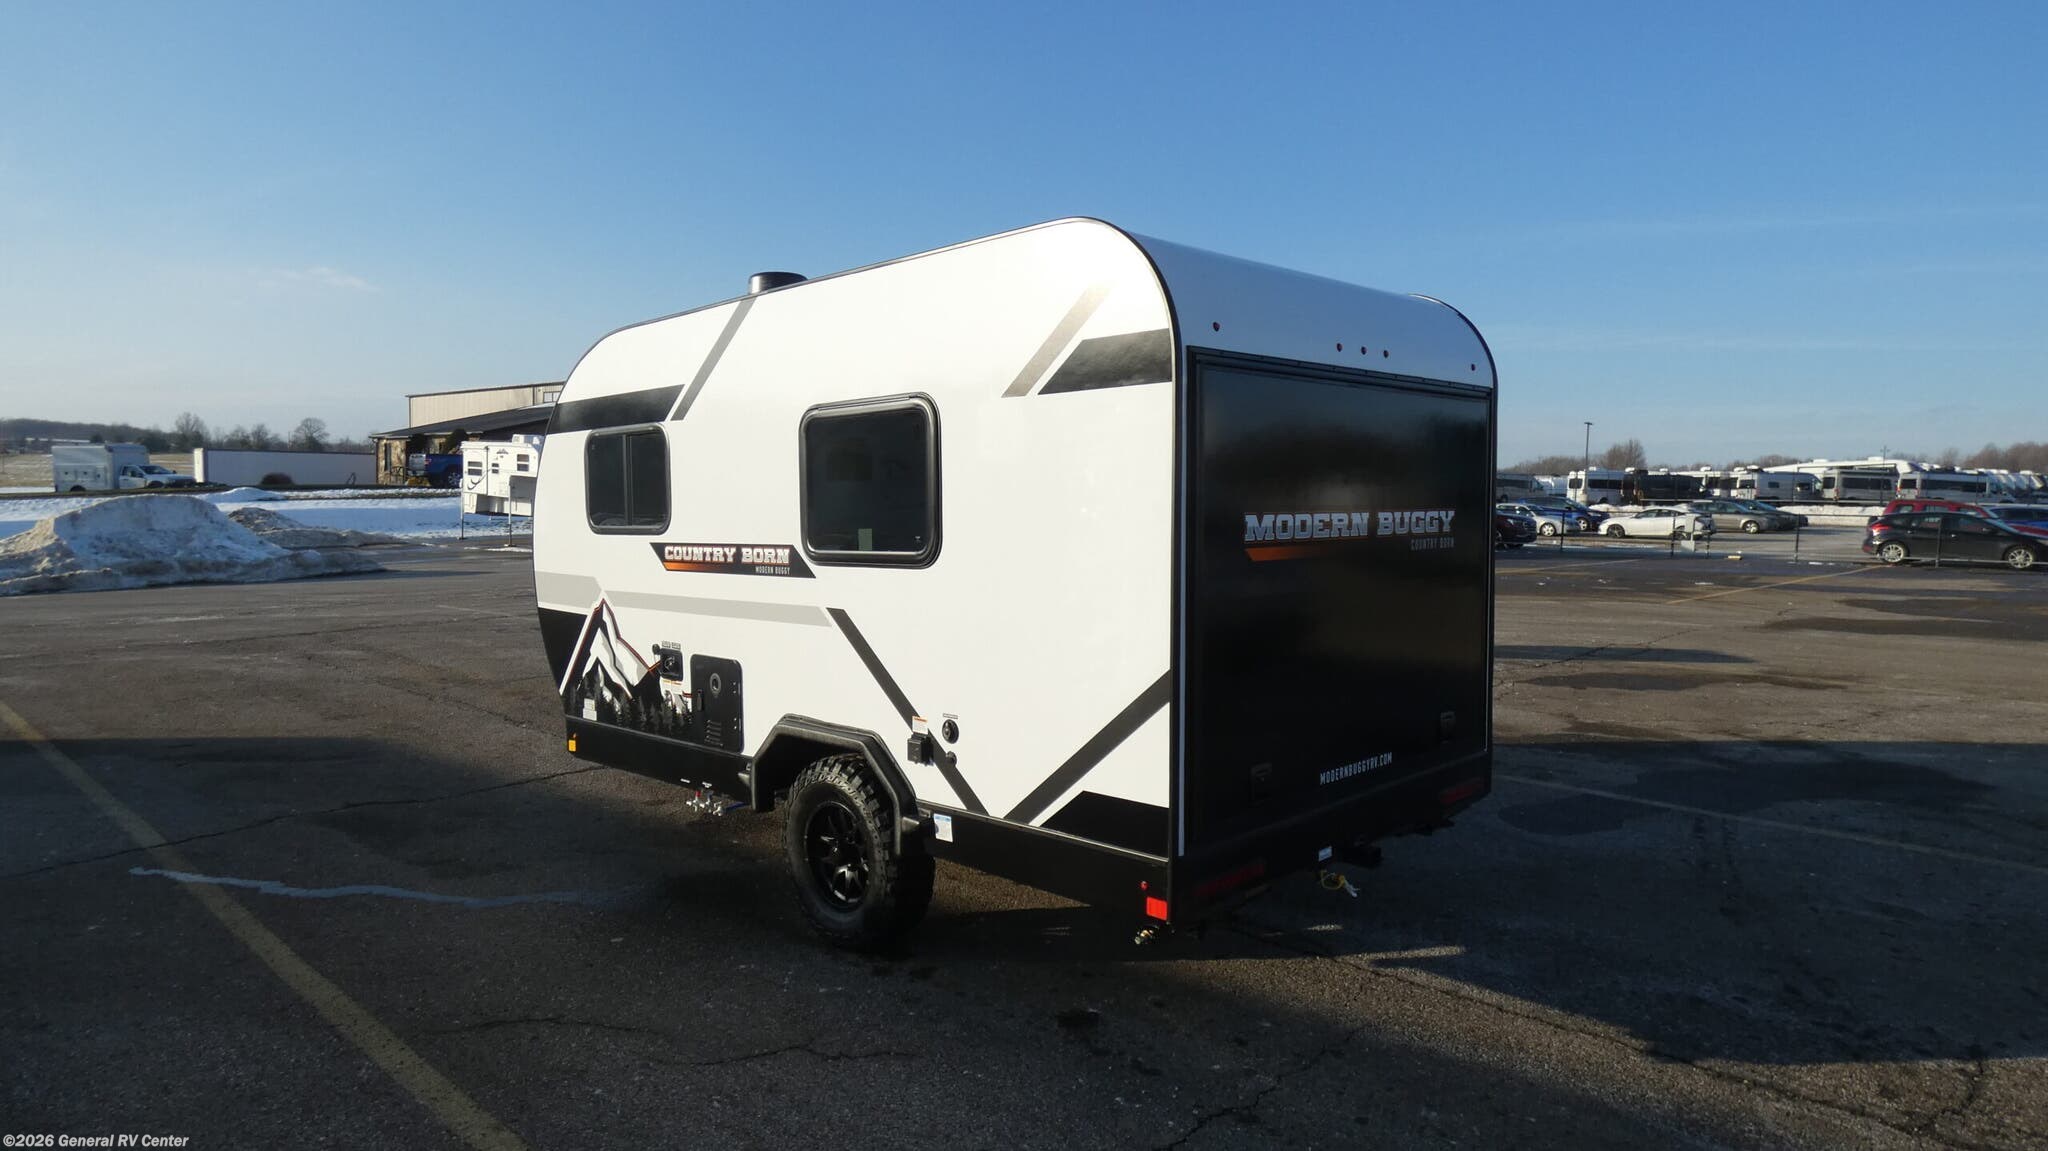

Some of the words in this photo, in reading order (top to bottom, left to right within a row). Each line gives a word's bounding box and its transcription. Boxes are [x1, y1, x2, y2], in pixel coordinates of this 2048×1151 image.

[1244, 512, 1369, 542] MODERN
[1377, 510, 1455, 535] BUGGY
[664, 546, 736, 563] COUNTRY
[741, 548, 790, 564] BORN
[755, 565, 774, 574] MODERN
[775, 566, 790, 575] BUGGY
[1320, 752, 1392, 785] MODERNBUGGYRV.COM
